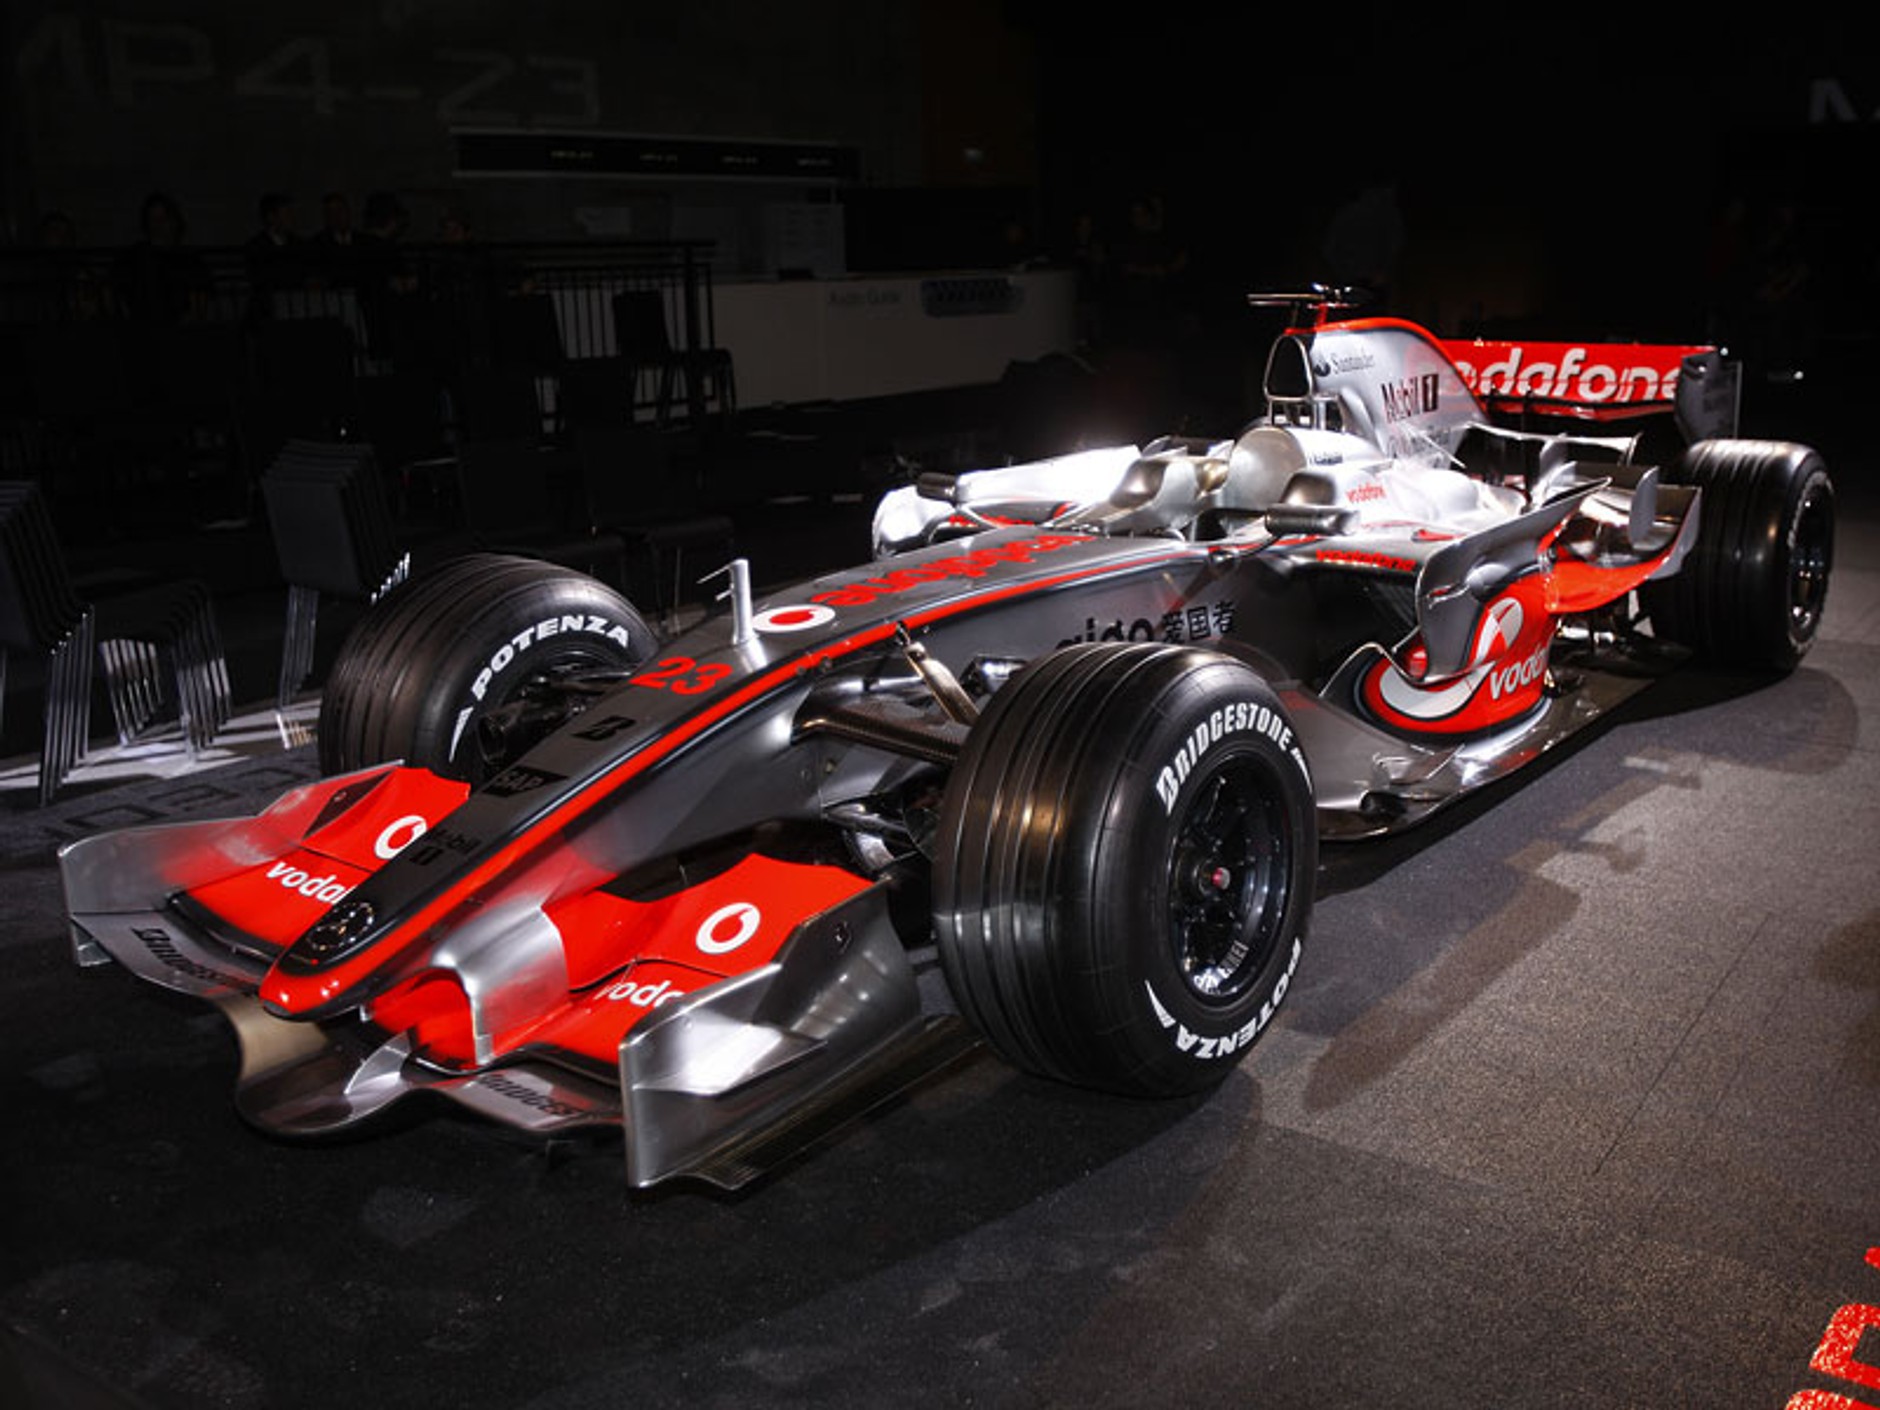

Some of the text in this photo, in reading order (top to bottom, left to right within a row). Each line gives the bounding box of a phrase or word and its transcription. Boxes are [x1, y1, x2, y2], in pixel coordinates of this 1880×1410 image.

[471, 614, 630, 701] POTENZA
[629, 656, 733, 695] 23
[1156, 702, 1293, 816] BRIDGESTONE
[1175, 937, 1302, 1059] POTENZA
